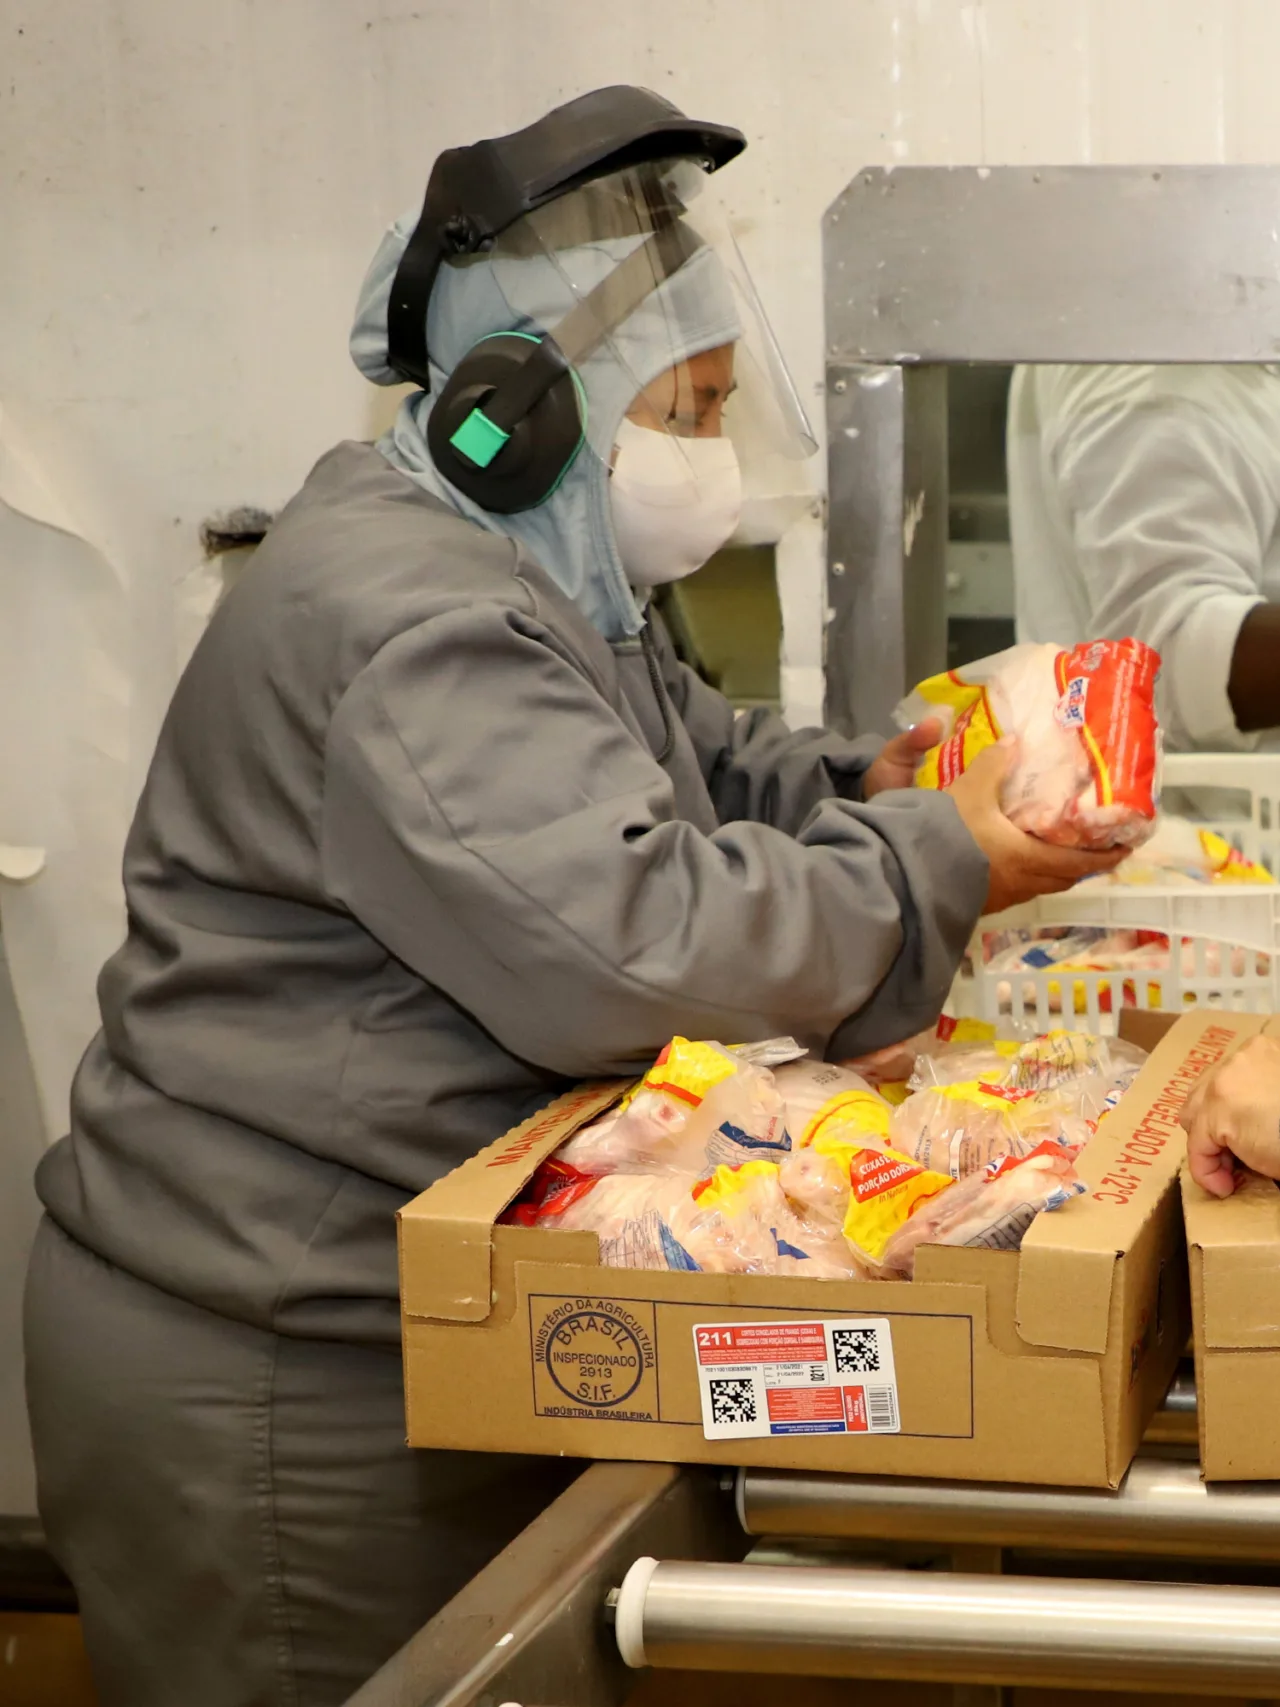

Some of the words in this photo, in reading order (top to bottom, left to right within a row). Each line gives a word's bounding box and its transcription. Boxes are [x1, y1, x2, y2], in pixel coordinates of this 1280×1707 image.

[1125, 1078, 1189, 1156] CONGELADO
[859, 1155, 884, 1174] COXAS
[1115, 1152, 1152, 1166] A
[858, 1172, 890, 1194] PORÇÃO
[535, 1302, 574, 1362] MINISTÉRIO
[576, 1299, 594, 1310] DA
[596, 1300, 655, 1369] AGRICULTURA
[556, 1316, 632, 1350] BRASIL
[699, 1332, 733, 1346] 211
[553, 1352, 636, 1368] INSPECIONADO
[580, 1366, 612, 1378] 2913
[810, 1365, 825, 1382] 0211
[577, 1382, 616, 1401] S.I.F.
[544, 1406, 594, 1417] INDÚSTRIA
[596, 1409, 652, 1420] BRASILEIRA
